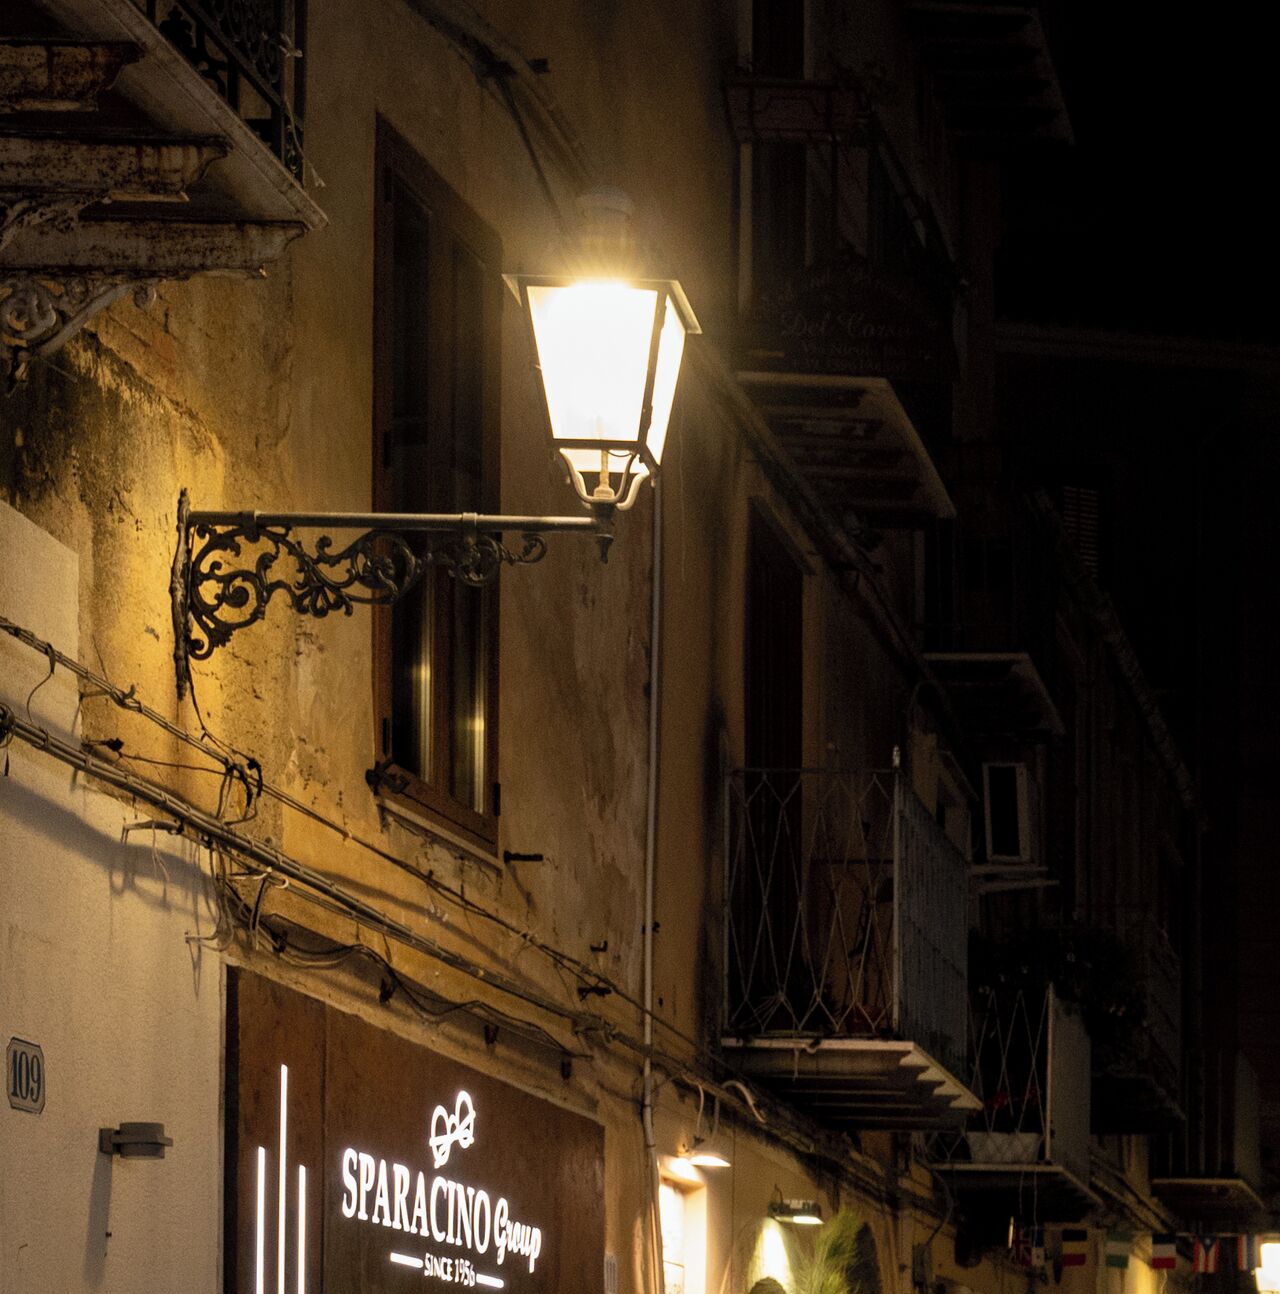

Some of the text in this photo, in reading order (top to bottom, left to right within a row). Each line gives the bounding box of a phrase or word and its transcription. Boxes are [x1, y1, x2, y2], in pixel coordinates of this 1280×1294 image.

[10, 1050, 42, 1104] 109
[341, 1147, 542, 1274] SPARACINO Group
[423, 1252, 477, 1288] SINCE 1956
